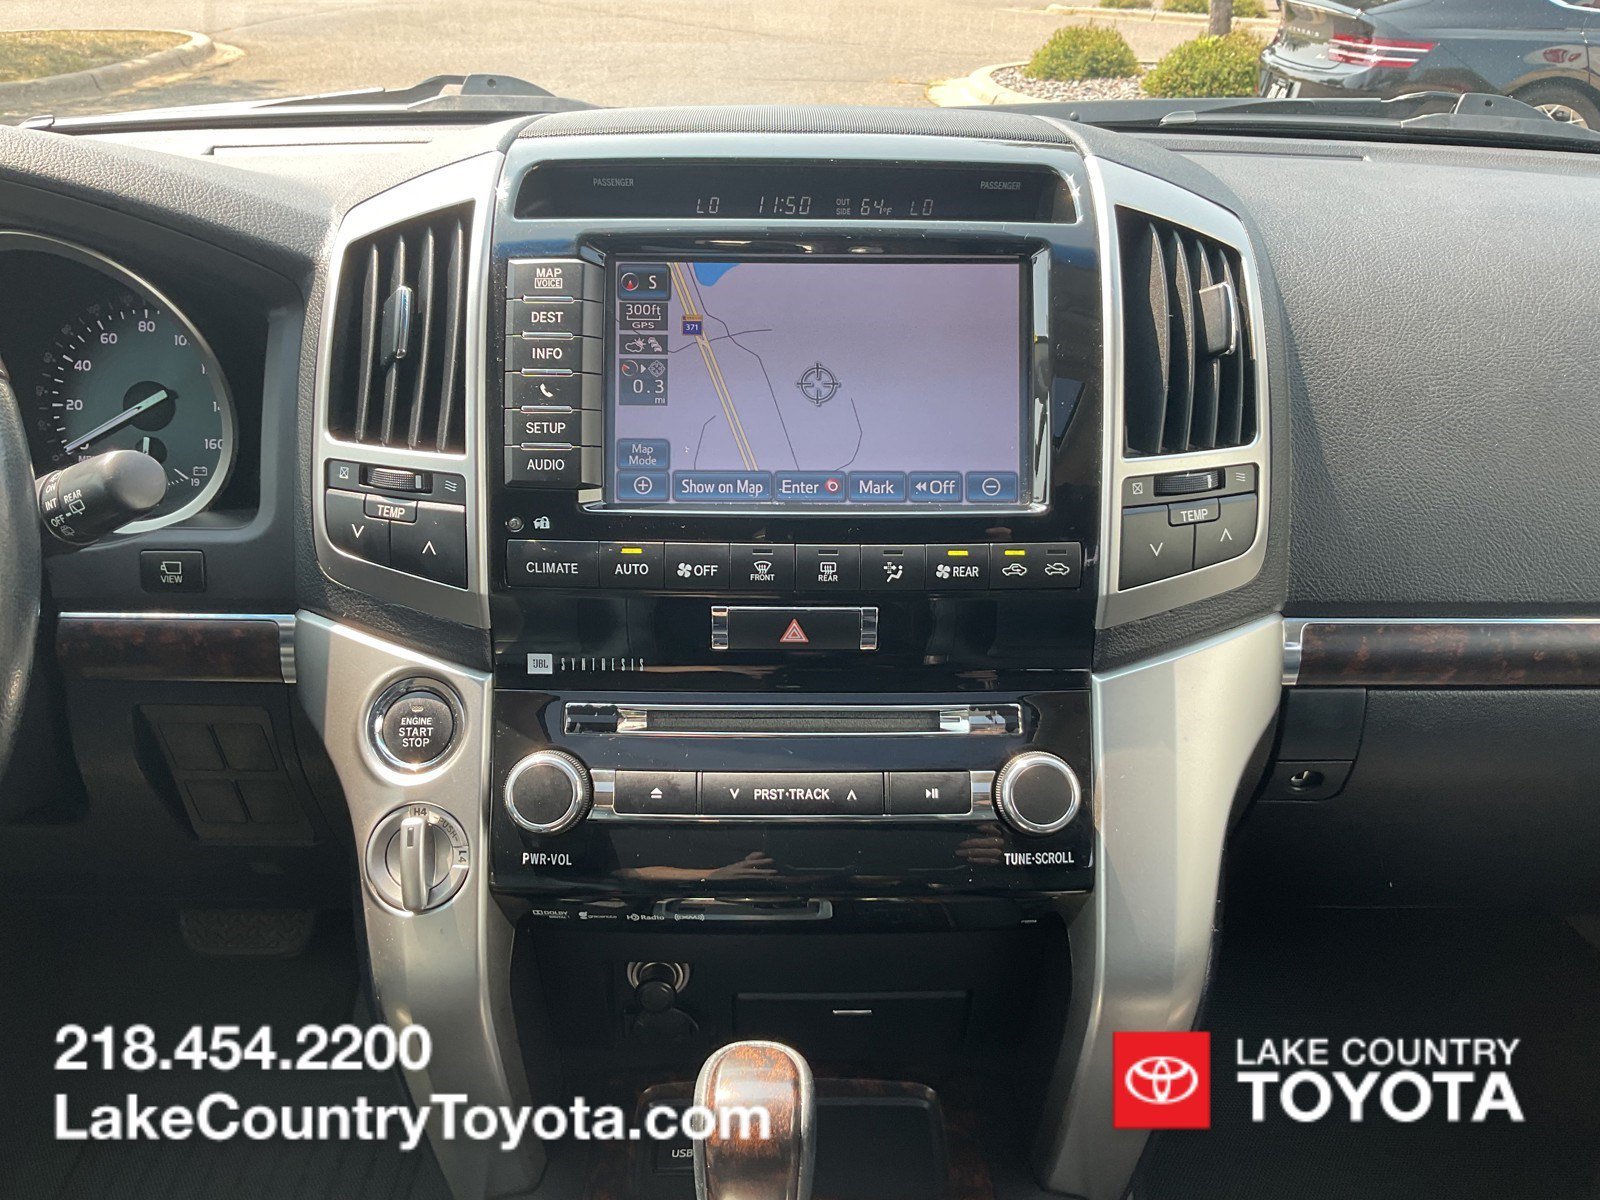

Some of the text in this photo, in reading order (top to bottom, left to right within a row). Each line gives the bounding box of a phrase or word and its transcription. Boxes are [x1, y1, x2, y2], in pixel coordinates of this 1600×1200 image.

[592, 177, 634, 187] PASSENGER
[980, 180, 1021, 190] PASSENGER
[758, 196, 811, 215] 11:50
[536, 268, 562, 278] MAP
[536, 279, 562, 287] VOICE
[648, 275, 657, 289] S
[626, 304, 661, 316] 300ft
[531, 312, 564, 323] DEST
[138, 321, 155, 332] 80
[685, 323, 699, 331] 371
[100, 333, 117, 344] 60
[531, 348, 563, 359] INFO
[74, 360, 91, 371] 40
[66, 399, 83, 410] 20
[525, 422, 566, 434] SETUP
[632, 445, 654, 456] Map
[527, 459, 565, 470] AUDIO
[629, 456, 657, 466] Mode
[190, 478, 200, 487] 19
[681, 479, 763, 496] Show on Map
[782, 480, 819, 493] Enter
[859, 480, 894, 493] Mark
[930, 480, 955, 494] Off
[63, 489, 82, 504] REAR
[45, 498, 57, 511] INT
[378, 504, 406, 518] TEMP
[1180, 508, 1209, 522] TEMP
[50, 514, 65, 527] OFF
[526, 562, 579, 574] CLIMATE
[615, 563, 649, 575] AUTO
[693, 565, 719, 577] OFF
[952, 566, 979, 578] REAR
[160, 575, 183, 584] VIEW
[818, 574, 838, 582] REAR
[533, 657, 644, 671] JBL SYNTHESIS
[401, 717, 432, 725] ENGINE
[398, 727, 434, 737] START
[402, 737, 430, 747] STOP
[413, 807, 427, 816] H4
[458, 850, 467, 863] L4
[671, 1149, 693, 1158] USB
